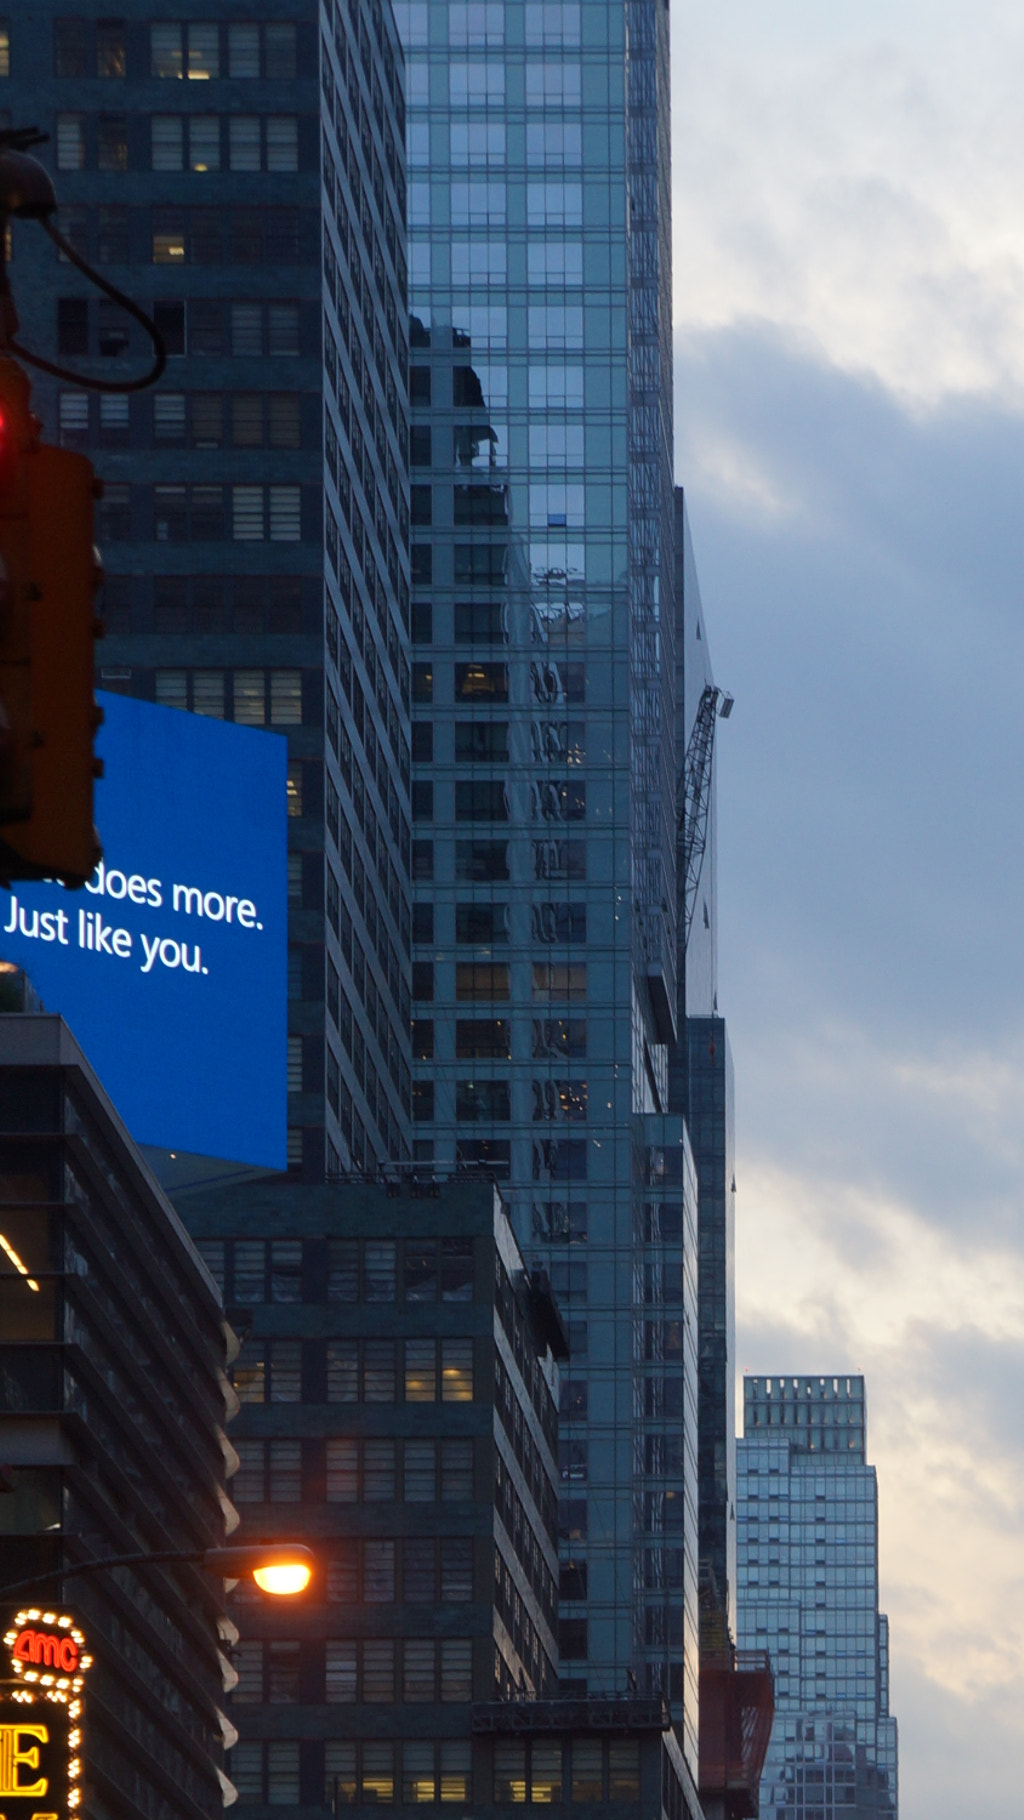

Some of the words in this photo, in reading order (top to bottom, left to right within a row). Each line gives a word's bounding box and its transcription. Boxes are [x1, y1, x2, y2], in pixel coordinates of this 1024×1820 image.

[84, 857, 163, 908] does
[172, 882, 264, 931] more.
[3, 895, 69, 945] Just
[78, 908, 133, 958] like
[140, 932, 210, 975] you.
